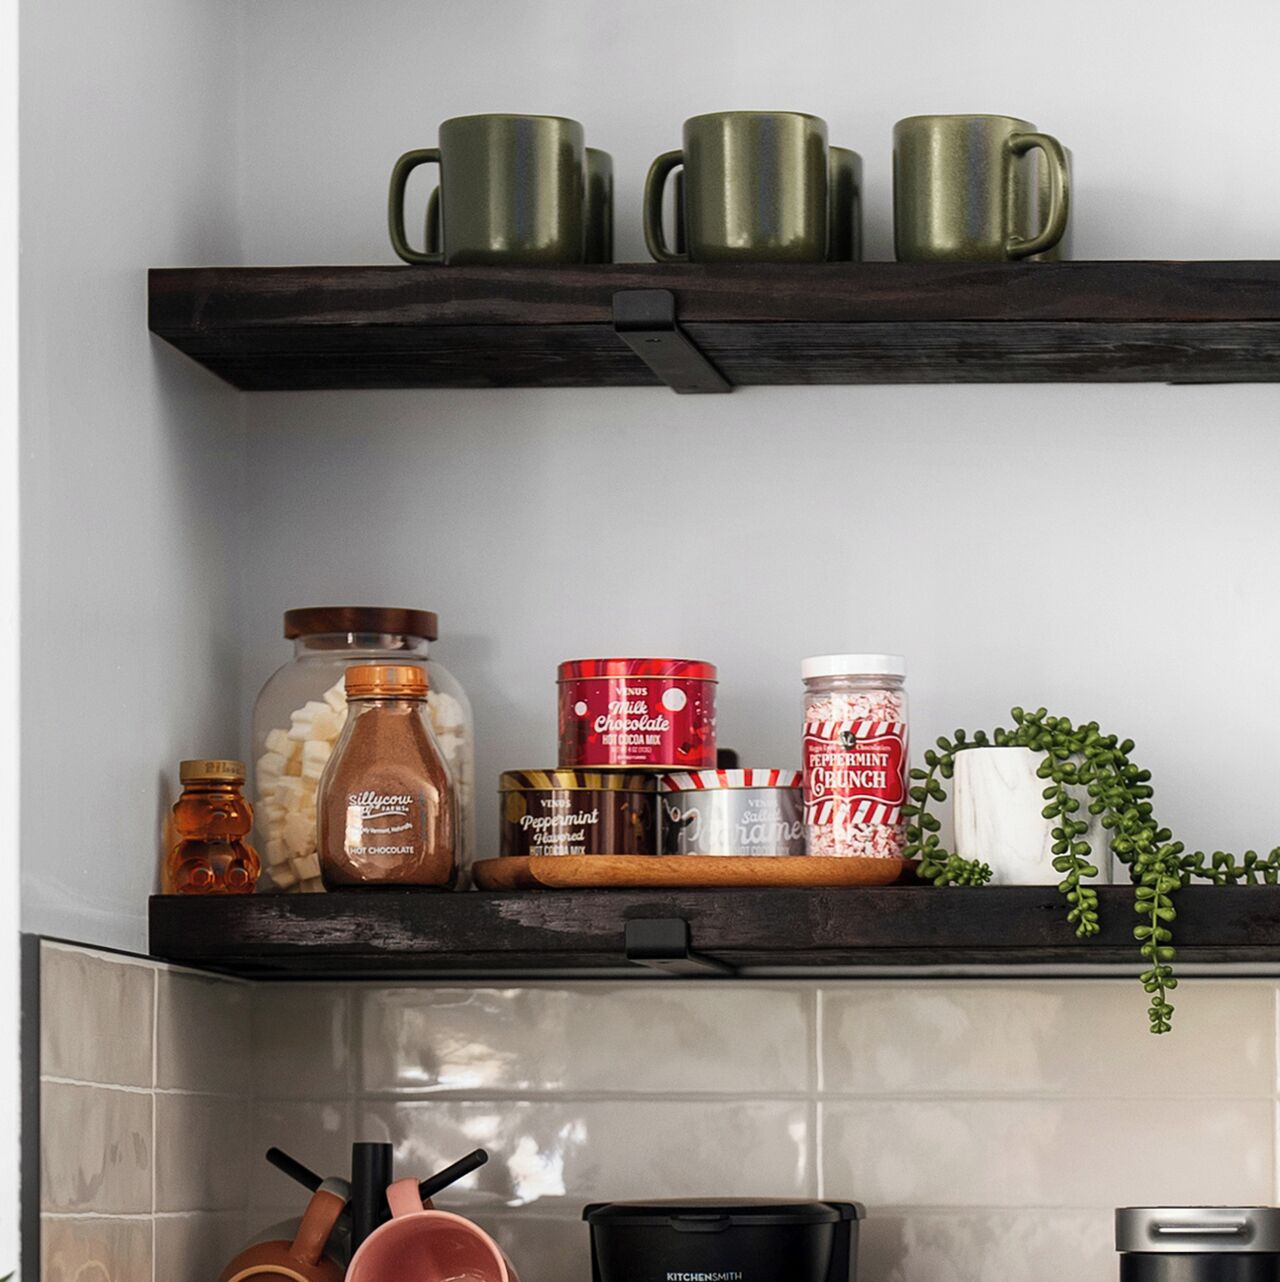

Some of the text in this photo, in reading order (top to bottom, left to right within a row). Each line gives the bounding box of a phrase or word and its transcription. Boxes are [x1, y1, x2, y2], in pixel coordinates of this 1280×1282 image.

[616, 687, 648, 696] VENUS
[608, 700, 649, 715] Milk
[594, 714, 670, 733] Chocolate
[602, 733, 661, 745] HOT COCOA MIX
[809, 752, 889, 767] PEPPERMINT
[811, 767, 887, 797] CRUNCH
[349, 790, 413, 813] Sillycow
[520, 807, 599, 832] Peppermint
[533, 829, 585, 845] Flavored
[350, 846, 414, 855] HOT CHOCOLATE
[666, 1271, 743, 1282] KITCHENSMITH
